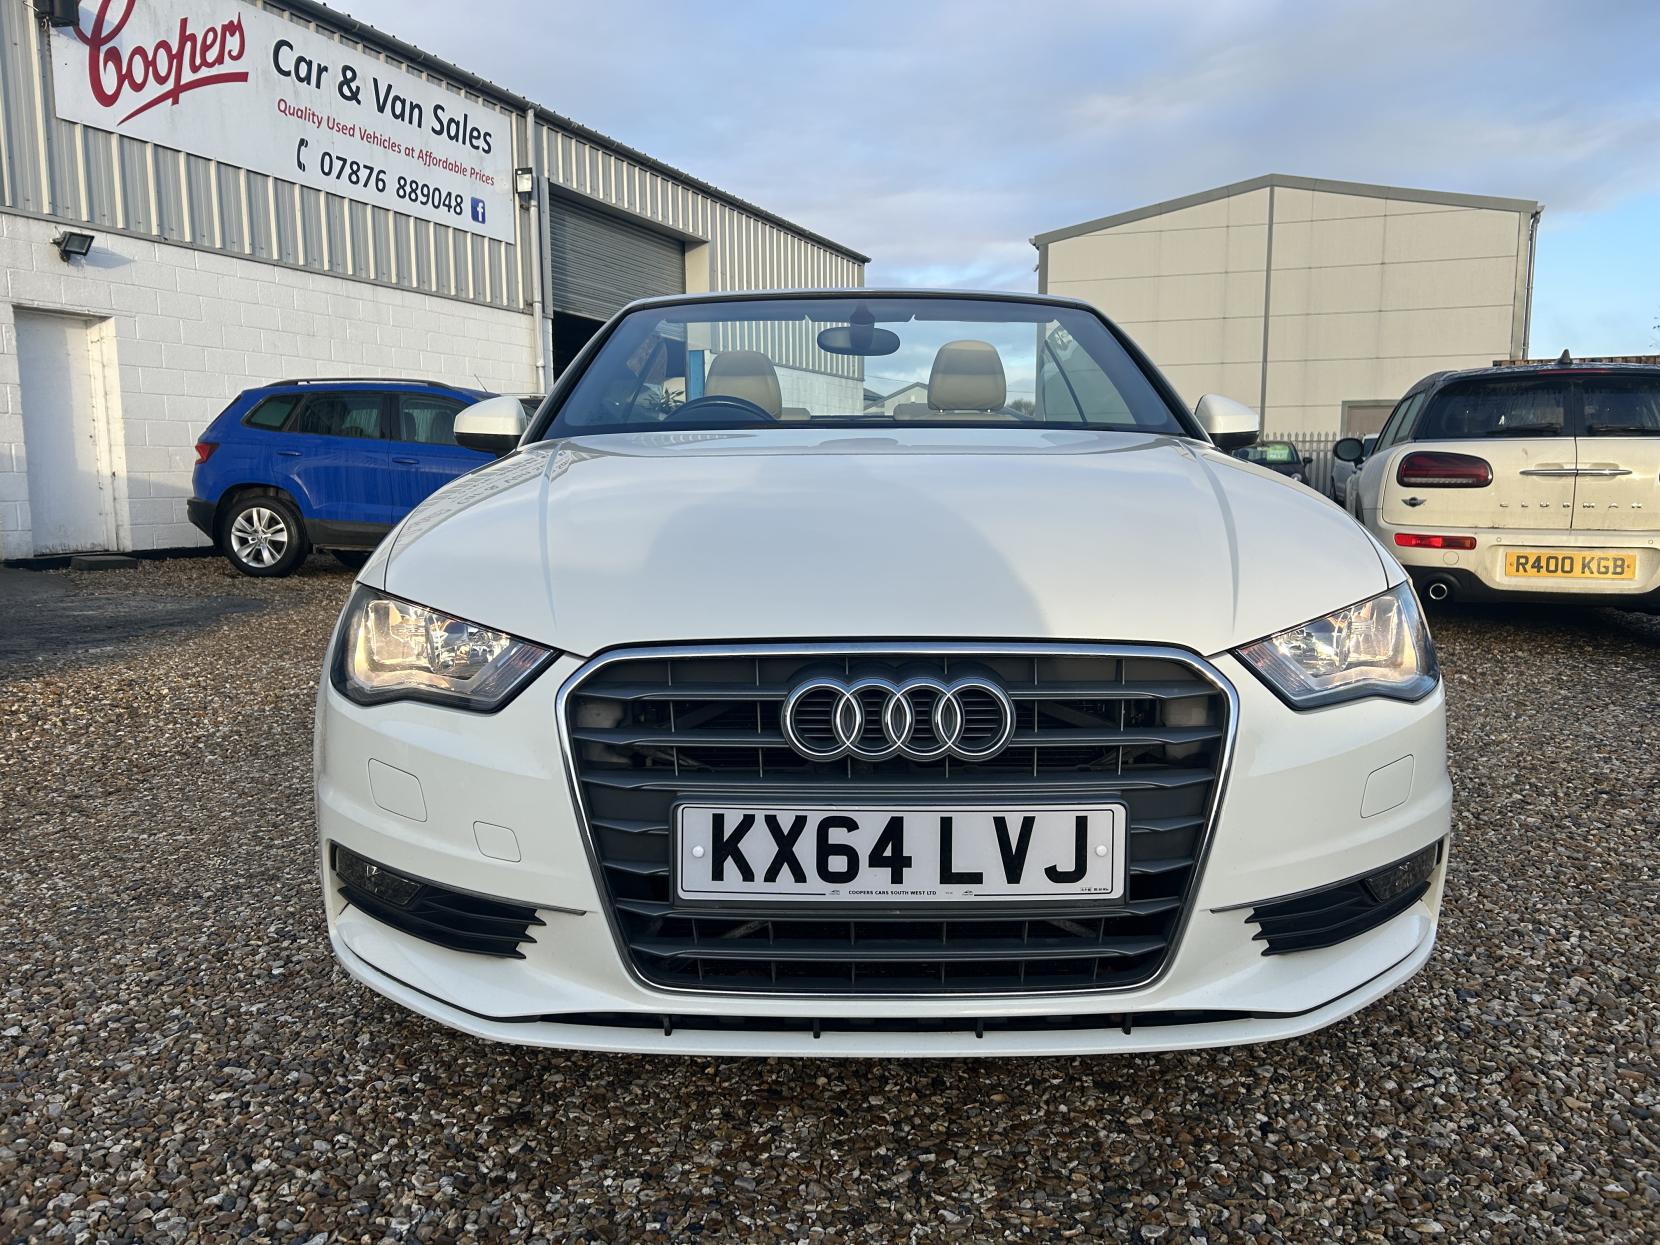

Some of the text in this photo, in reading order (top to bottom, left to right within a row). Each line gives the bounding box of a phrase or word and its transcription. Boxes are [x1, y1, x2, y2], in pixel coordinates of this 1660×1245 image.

[73, 0, 247, 108] Coopers
[272, 38, 493, 155] Car & Van Sales
[277, 98, 495, 186] Quality Used Vehicles at Affordable Prices
[320, 151, 464, 216] 07876 889048
[1515, 555, 1626, 575] R400 KGB
[711, 812, 1089, 885] KX64 LVJ
